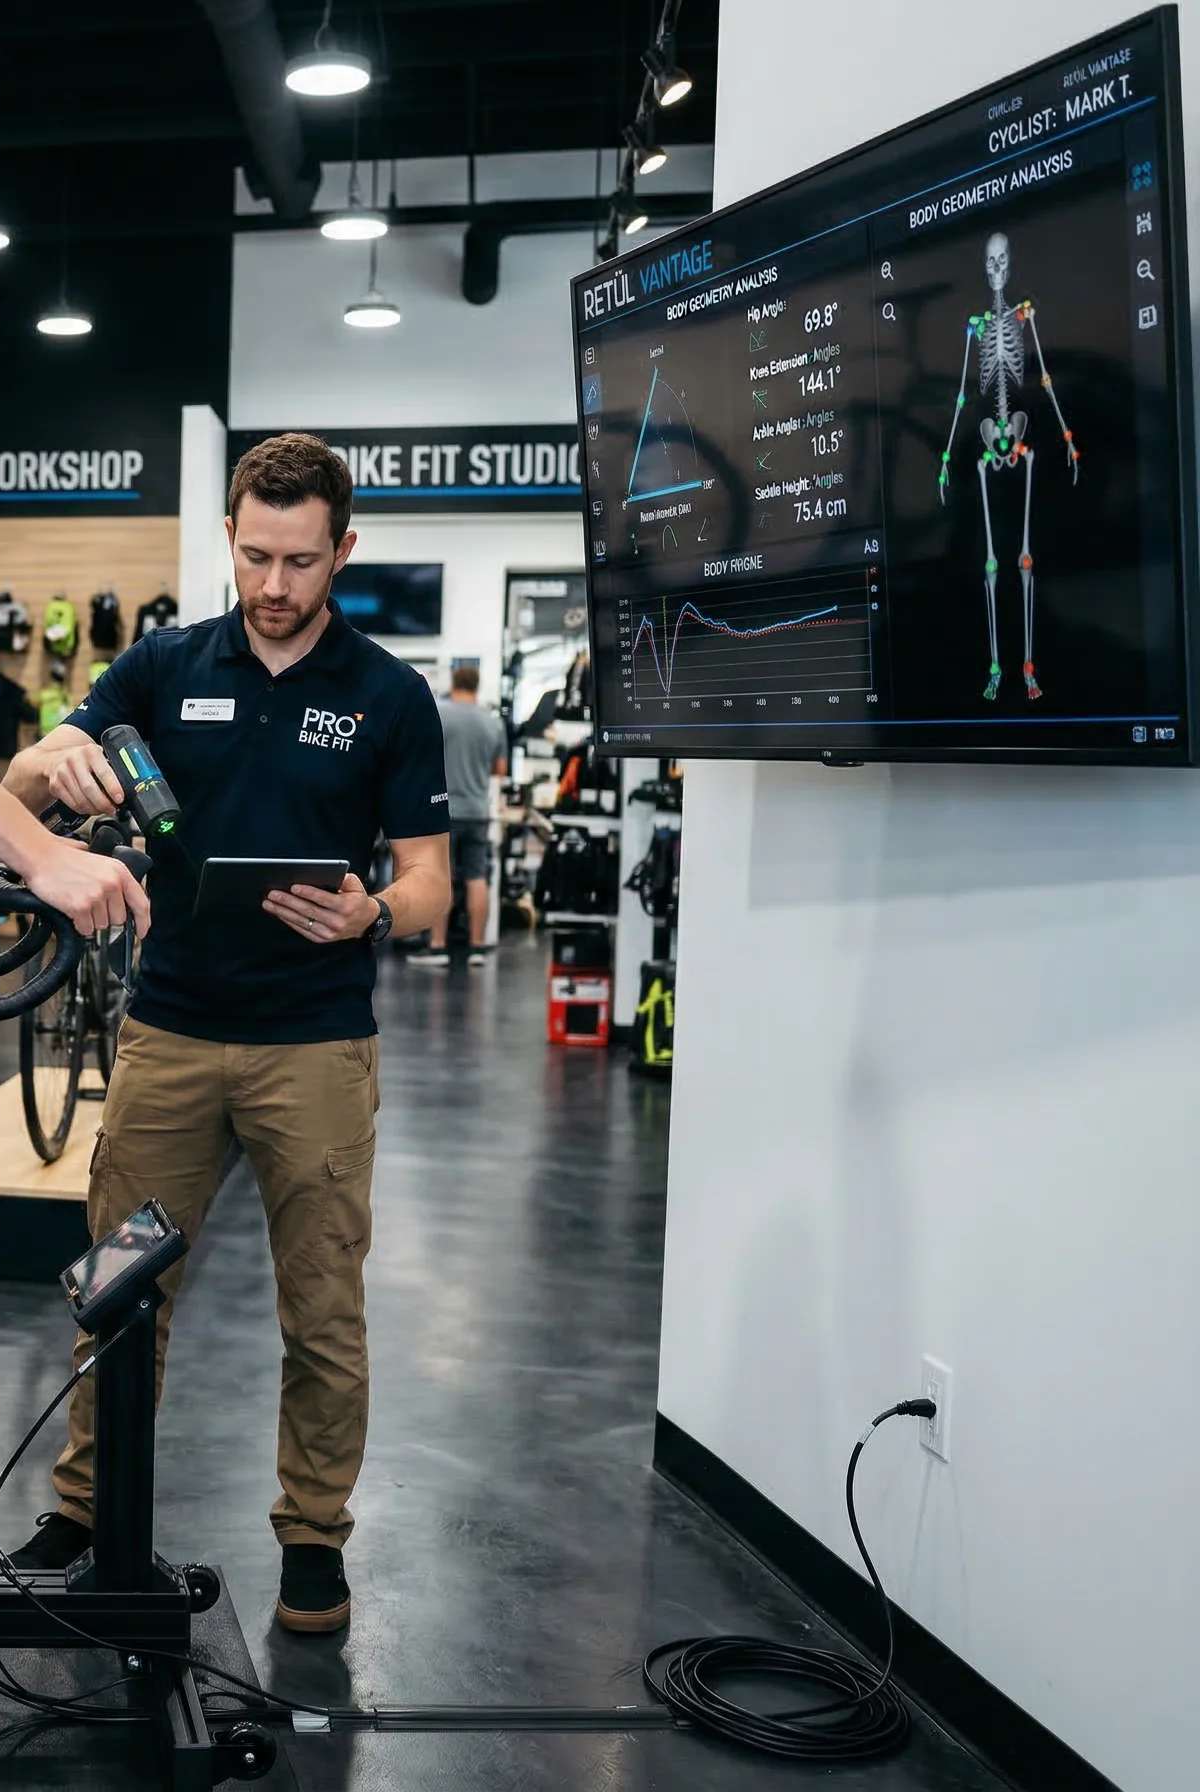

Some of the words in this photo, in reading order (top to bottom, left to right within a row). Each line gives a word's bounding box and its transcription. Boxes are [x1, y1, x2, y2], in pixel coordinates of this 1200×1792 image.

[988, 107, 1057, 153] CYCLIST:
[1065, 80, 1116, 122] MARK
[1119, 74, 1133, 98] T.
[909, 201, 940, 229] BODY
[941, 175, 1008, 216] GEOMETRY
[1010, 149, 1073, 191] ANALYSIS
[583, 269, 636, 321] RETÜL
[639, 239, 714, 295] VANTAGE
[666, 299, 690, 321] BODY
[804, 301, 838, 333] 69.8°
[798, 364, 841, 397] 144.1°
[810, 429, 844, 457] 10.5°
[410, 443, 463, 487] FIT
[793, 498, 823, 523] 75.4
[826, 498, 847, 518] cm
[704, 560, 729, 577] BODY
[302, 707, 357, 738] PRO
[298, 729, 330, 748] BIKE
[332, 736, 353, 752] FIT
